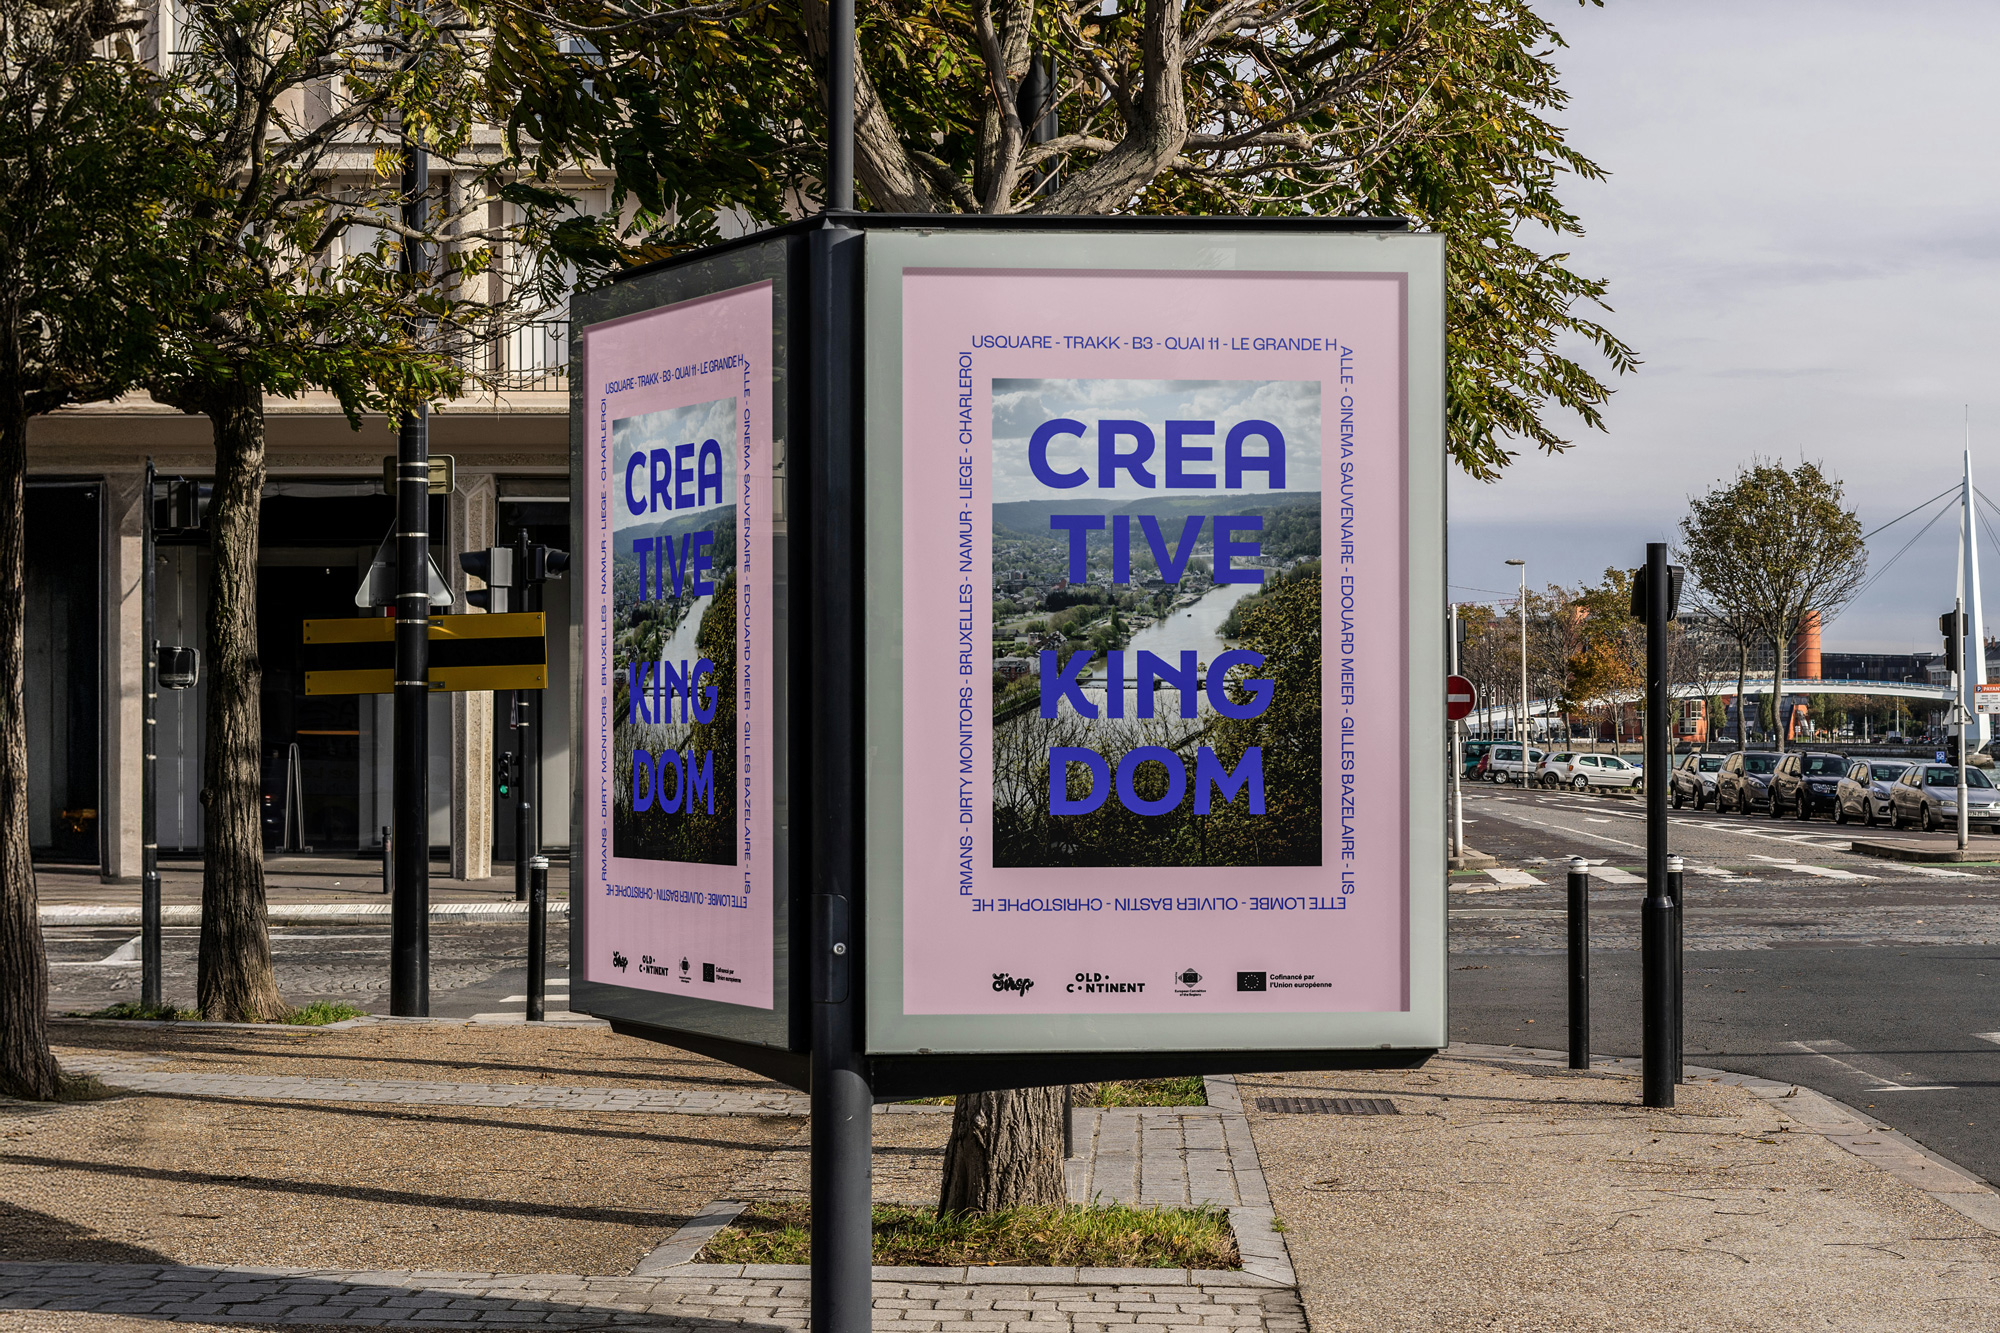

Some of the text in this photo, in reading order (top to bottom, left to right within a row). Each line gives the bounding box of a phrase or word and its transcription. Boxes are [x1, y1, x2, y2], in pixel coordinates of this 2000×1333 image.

[971, 335, 1052, 350] USQUARE
[1062, 335, 1121, 350] TRAKK
[1132, 336, 1153, 350] B3
[1164, 336, 1204, 351] QUAI
[1207, 337, 1220, 351] 11
[1232, 337, 1250, 351] LE
[1253, 337, 1323, 352] GRANDE
[1325, 338, 1338, 352] H
[1339, 344, 1355, 385] ALLE
[958, 351, 974, 446] CHARLEROI
[1339, 394, 1355, 460] CINEMA
[625, 438, 723, 516] CREA
[958, 455, 973, 500] LIEGE
[1028, 418, 1286, 491] CREA
[958, 510, 974, 573] NAMUR
[1339, 461, 1355, 564] SAUVENAIRE
[633, 529, 715, 602] TIVE
[1050, 514, 1265, 585] TIVE
[959, 583, 974, 676] BRUXELLES
[1340, 575, 1355, 655] EDOUARD
[630, 656, 719, 725] KING
[1040, 649, 1275, 720] KING
[1340, 657, 1355, 706] MEIER
[959, 686, 974, 774] MONITORS
[1340, 716, 1355, 771] GILLES
[633, 748, 715, 817] DOM
[959, 776, 974, 825] DIRTY
[1049, 745, 1266, 817] DOM
[1340, 773, 1356, 861] BAZELAIRE
[959, 835, 974, 896] RMANS
[1341, 871, 1356, 895] LIS
[972, 898, 995, 913] HE
[996, 898, 1103, 913] CHRISTOPHE
[1114, 897, 1173, 912] BASTIN
[1175, 897, 1239, 912] OLIVIER
[1248, 897, 1306, 911] LOMBE
[1308, 896, 1347, 911] ETTE
